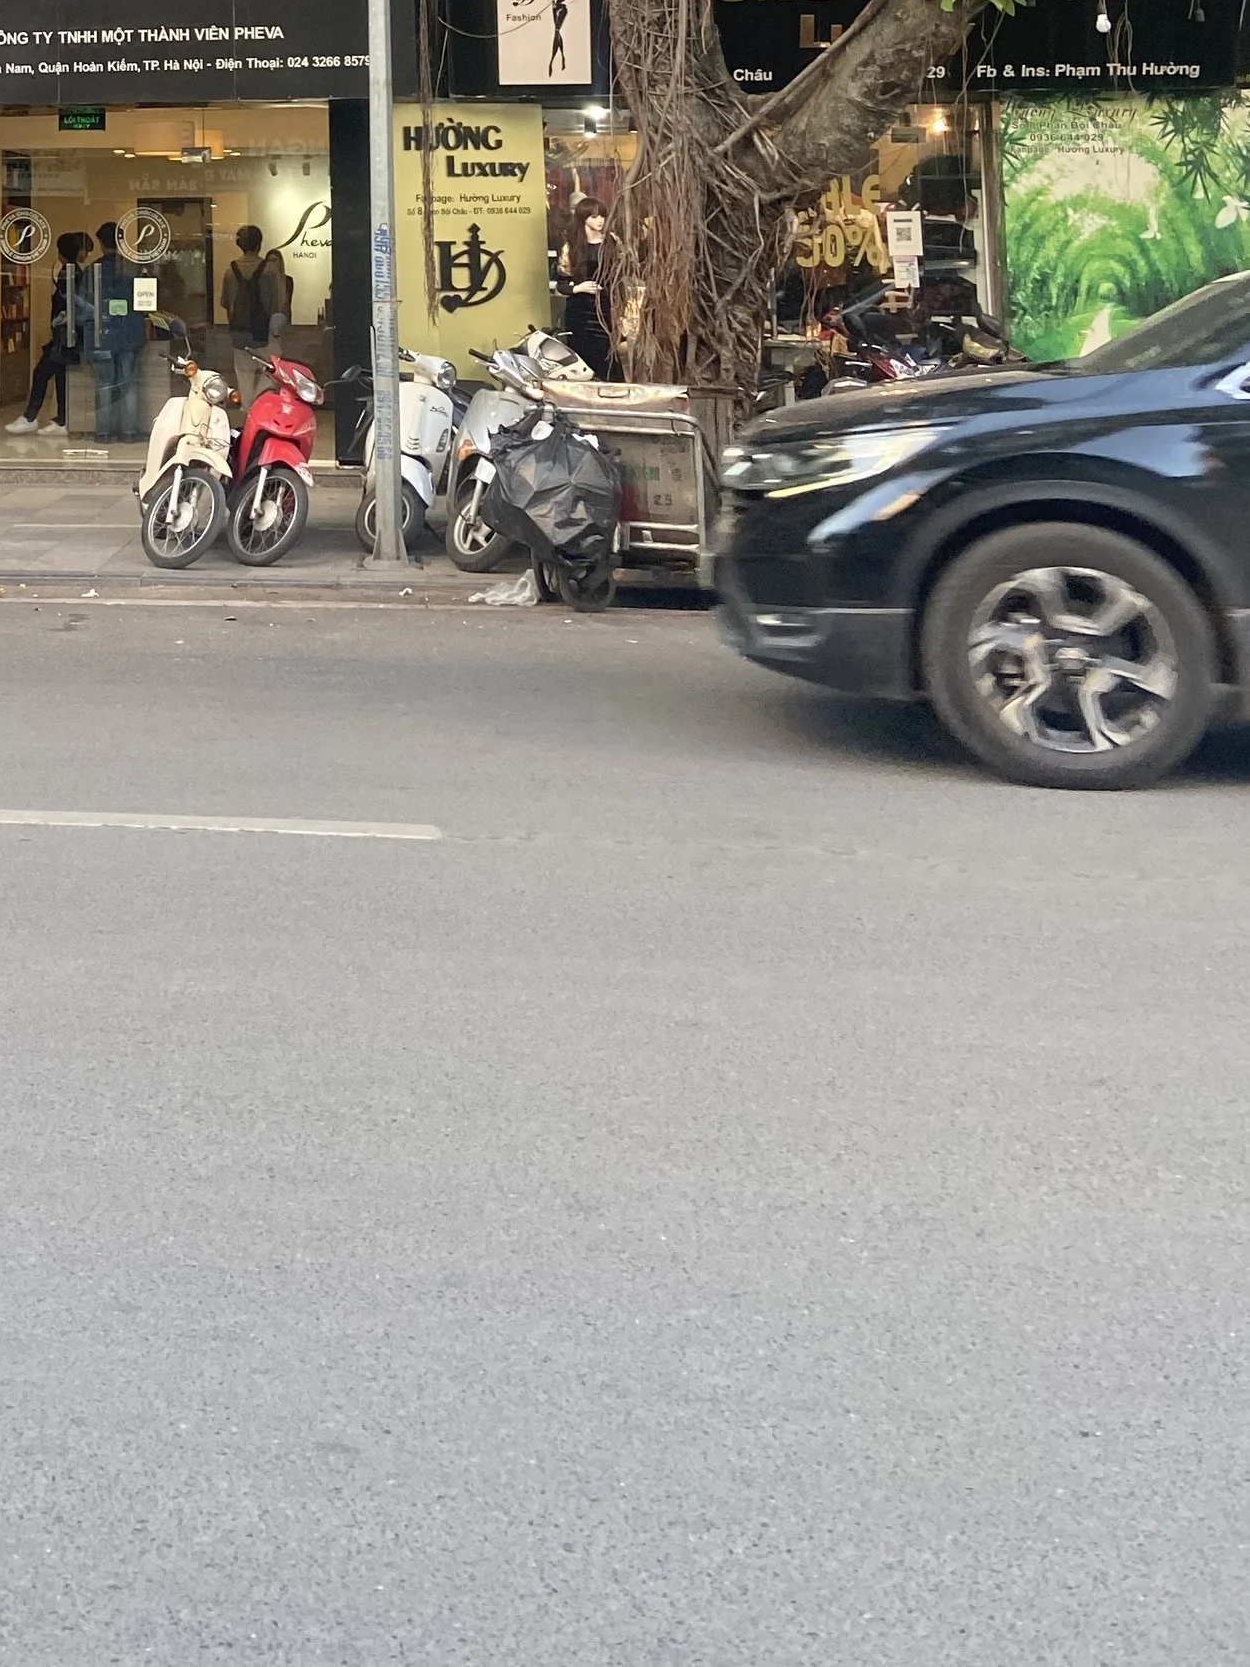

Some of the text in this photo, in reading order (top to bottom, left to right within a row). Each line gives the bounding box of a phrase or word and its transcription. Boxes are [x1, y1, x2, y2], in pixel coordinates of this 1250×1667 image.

[506, 13, 541, 22] Fashion
[33, 32, 54, 46] TY
[59, 30, 98, 44] TNHH
[101, 27, 134, 45] MỘT
[138, 26, 190, 42] THÀNH
[194, 25, 230, 41] VIÊN
[234, 26, 284, 40] PHEVA
[5, 63, 35, 75] Nam,
[38, 62, 69, 75] Quận
[108, 58, 141, 73] Kiếm,
[164, 59, 180, 71] Hà
[183, 59, 204, 72] Nội
[215, 58, 242, 71] Điện
[246, 57, 284, 71] Thoại:
[287, 56, 309, 68] 024
[312, 56, 341, 67] 3266
[733, 62, 1200, 81] Châu 29 Fb & Ins: Phạm Thu Hường
[1093, 145, 1124, 155] Luxury
[446, 155, 530, 183] LUXURY
[460, 194, 489, 204] Hường
[492, 194, 521, 203] Luxury
[821, 174, 881, 217] ALE
